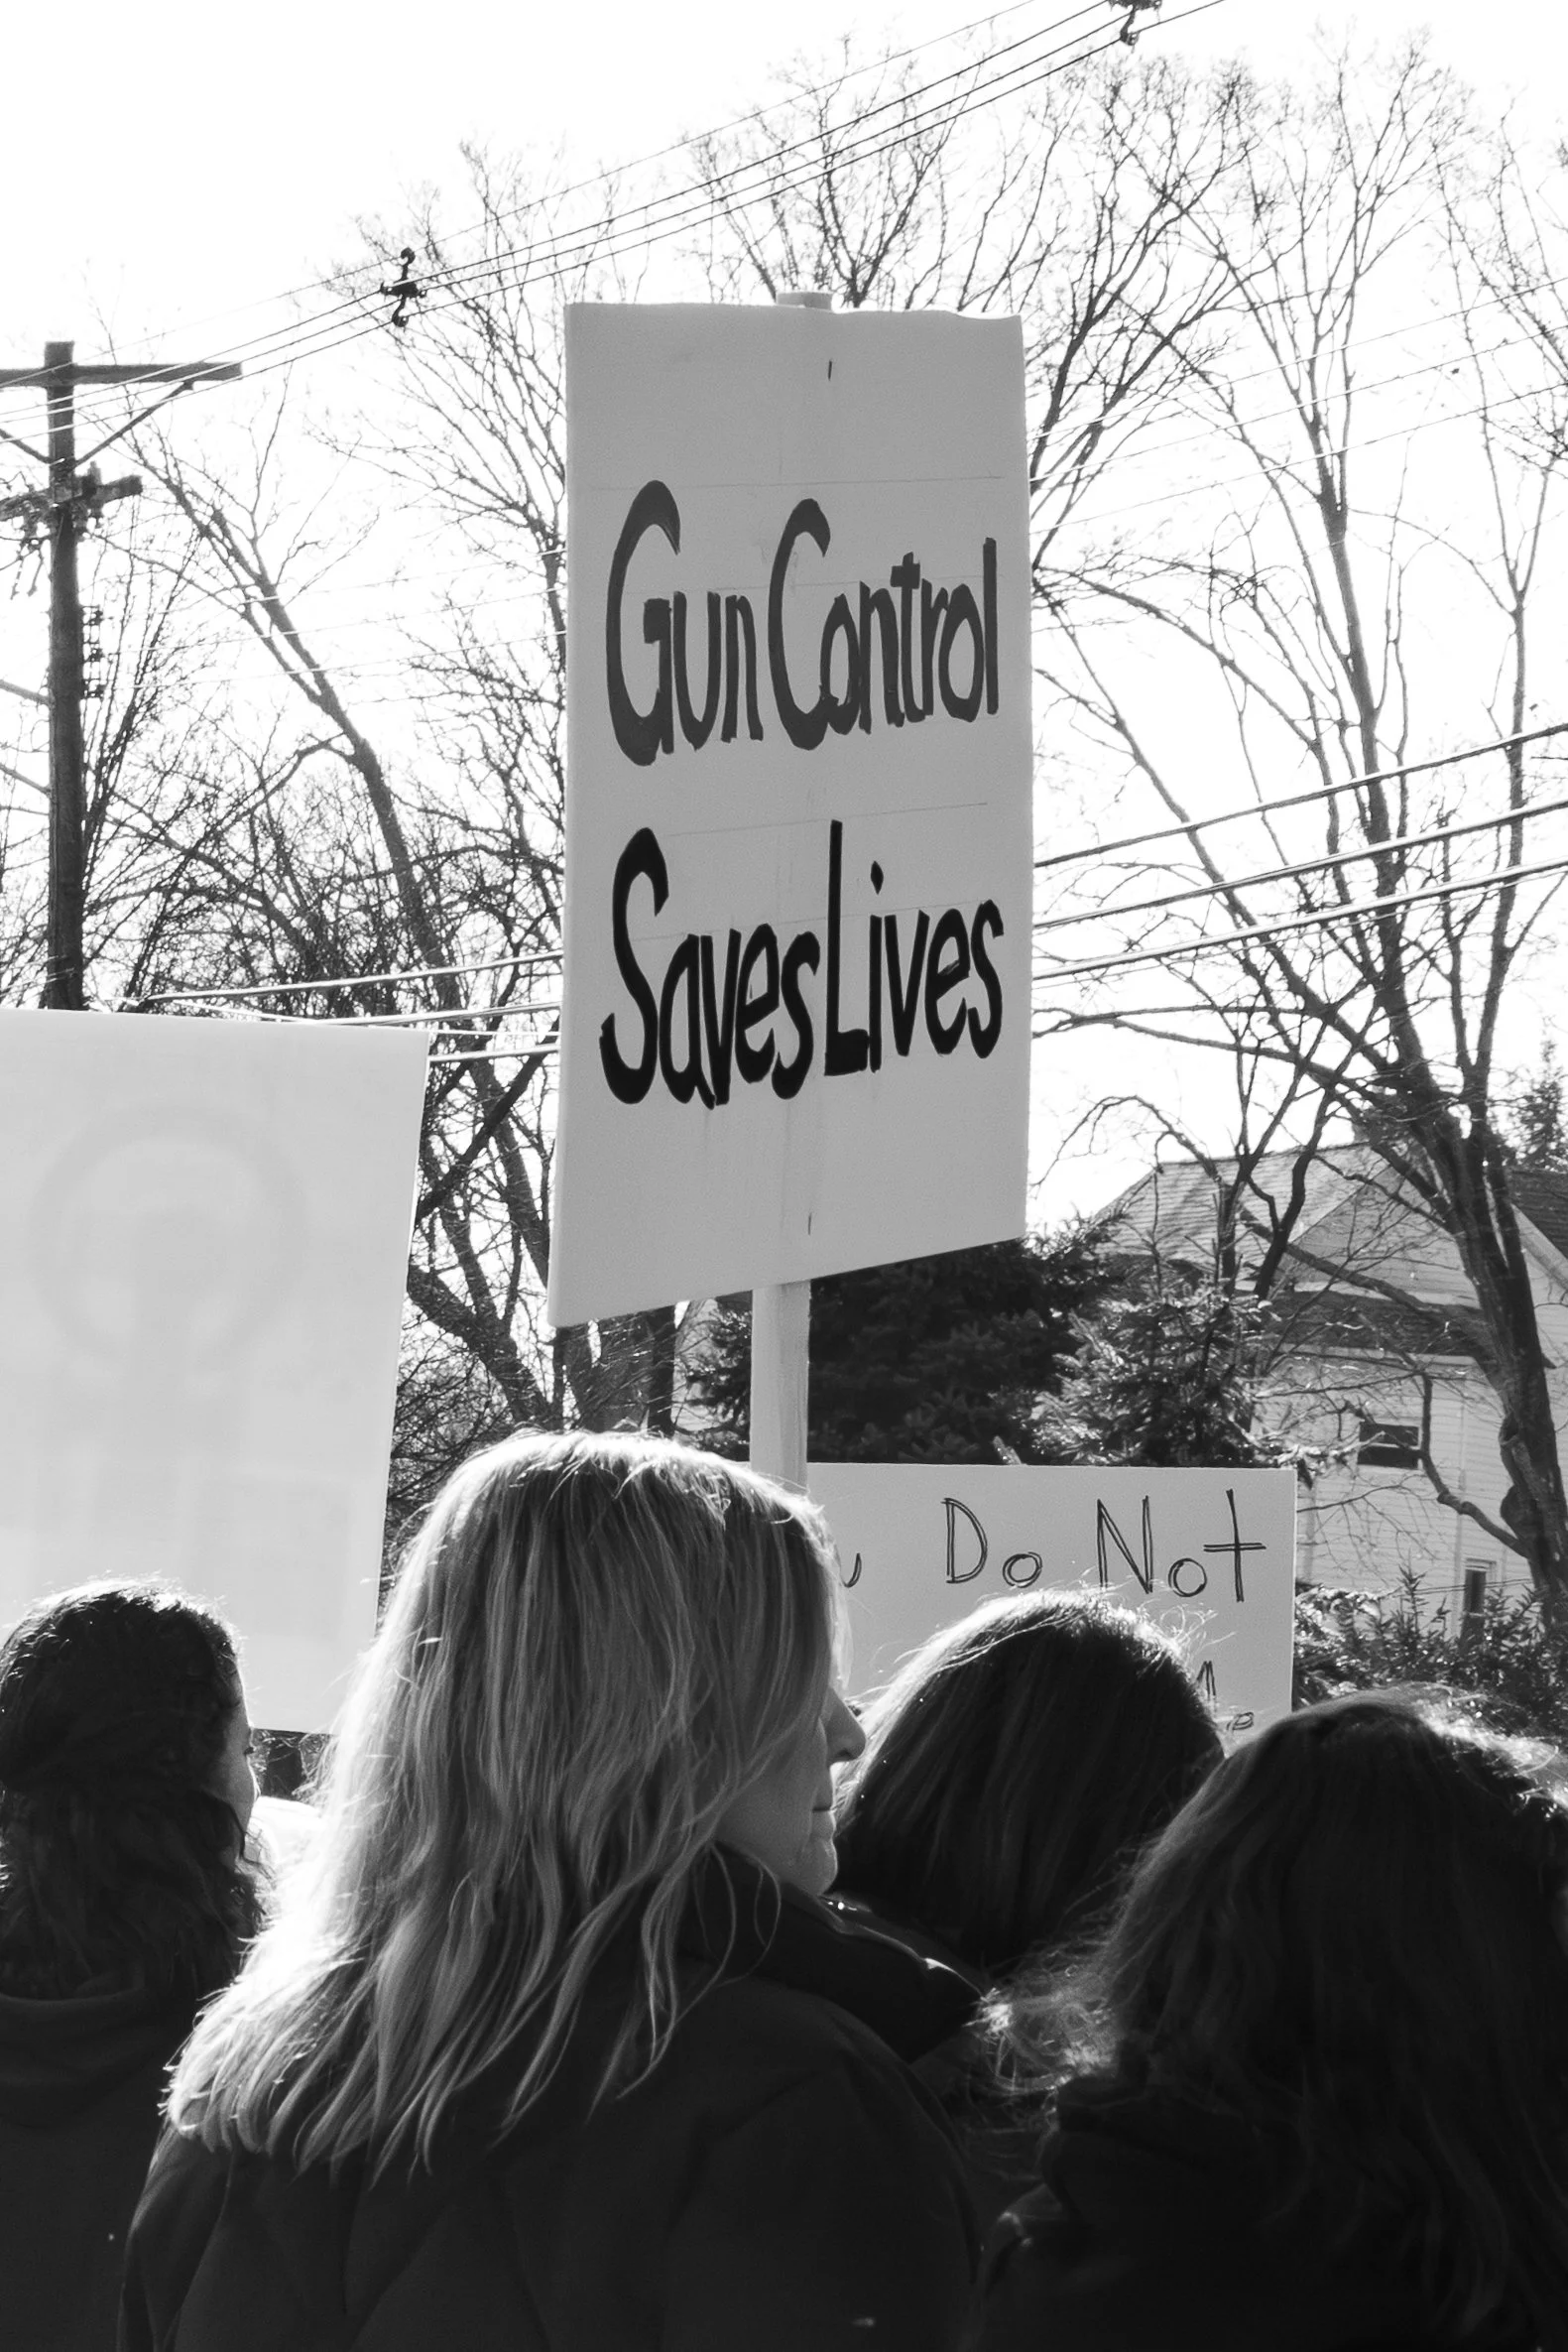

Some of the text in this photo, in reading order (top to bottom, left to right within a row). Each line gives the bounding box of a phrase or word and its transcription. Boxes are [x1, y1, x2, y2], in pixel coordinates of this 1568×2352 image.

[606, 479, 1000, 767] Gun Control
[599, 819, 1005, 1110] Saves Lives
[940, 1489, 1267, 1602] Do Not
